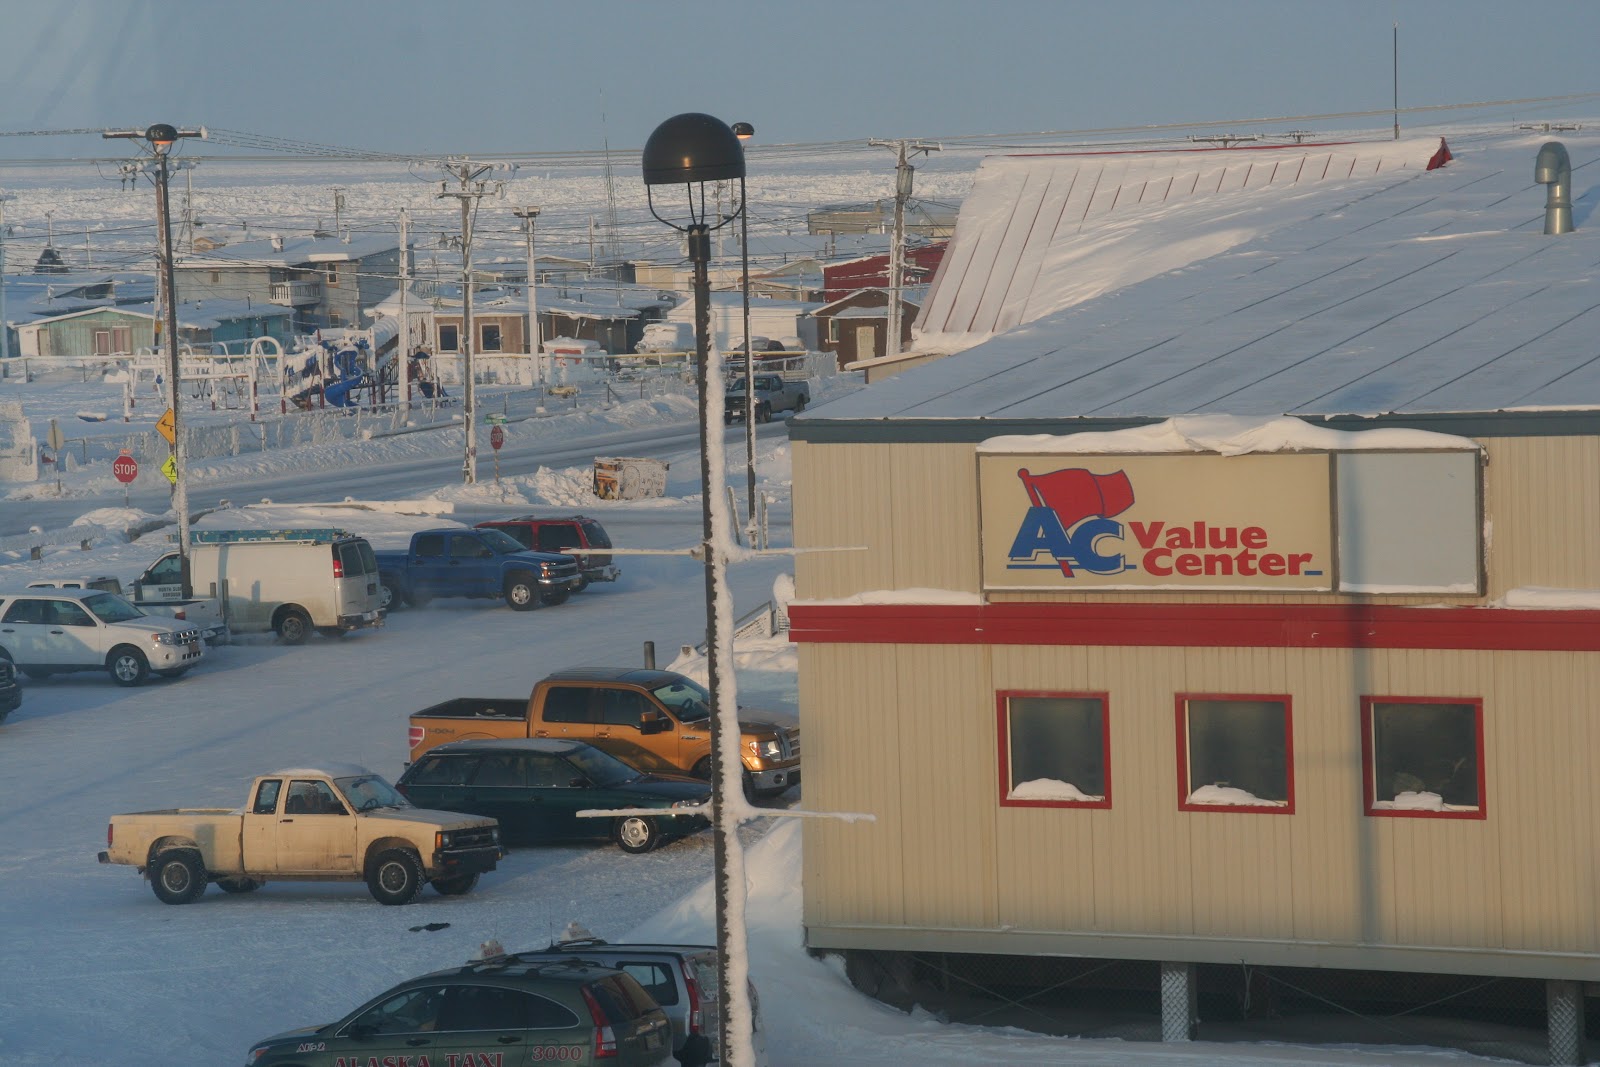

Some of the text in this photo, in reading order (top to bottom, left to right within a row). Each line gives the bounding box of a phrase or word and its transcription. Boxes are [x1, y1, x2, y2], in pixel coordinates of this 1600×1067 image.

[491, 432, 502, 443] STOP
[114, 463, 137, 475] STOP
[1007, 506, 1125, 576] AC
[1128, 521, 1268, 550] Value
[1142, 547, 1313, 577] Center
[334, 1052, 505, 1067] ALASKA TAXI
[532, 1045, 583, 1061] 3000
